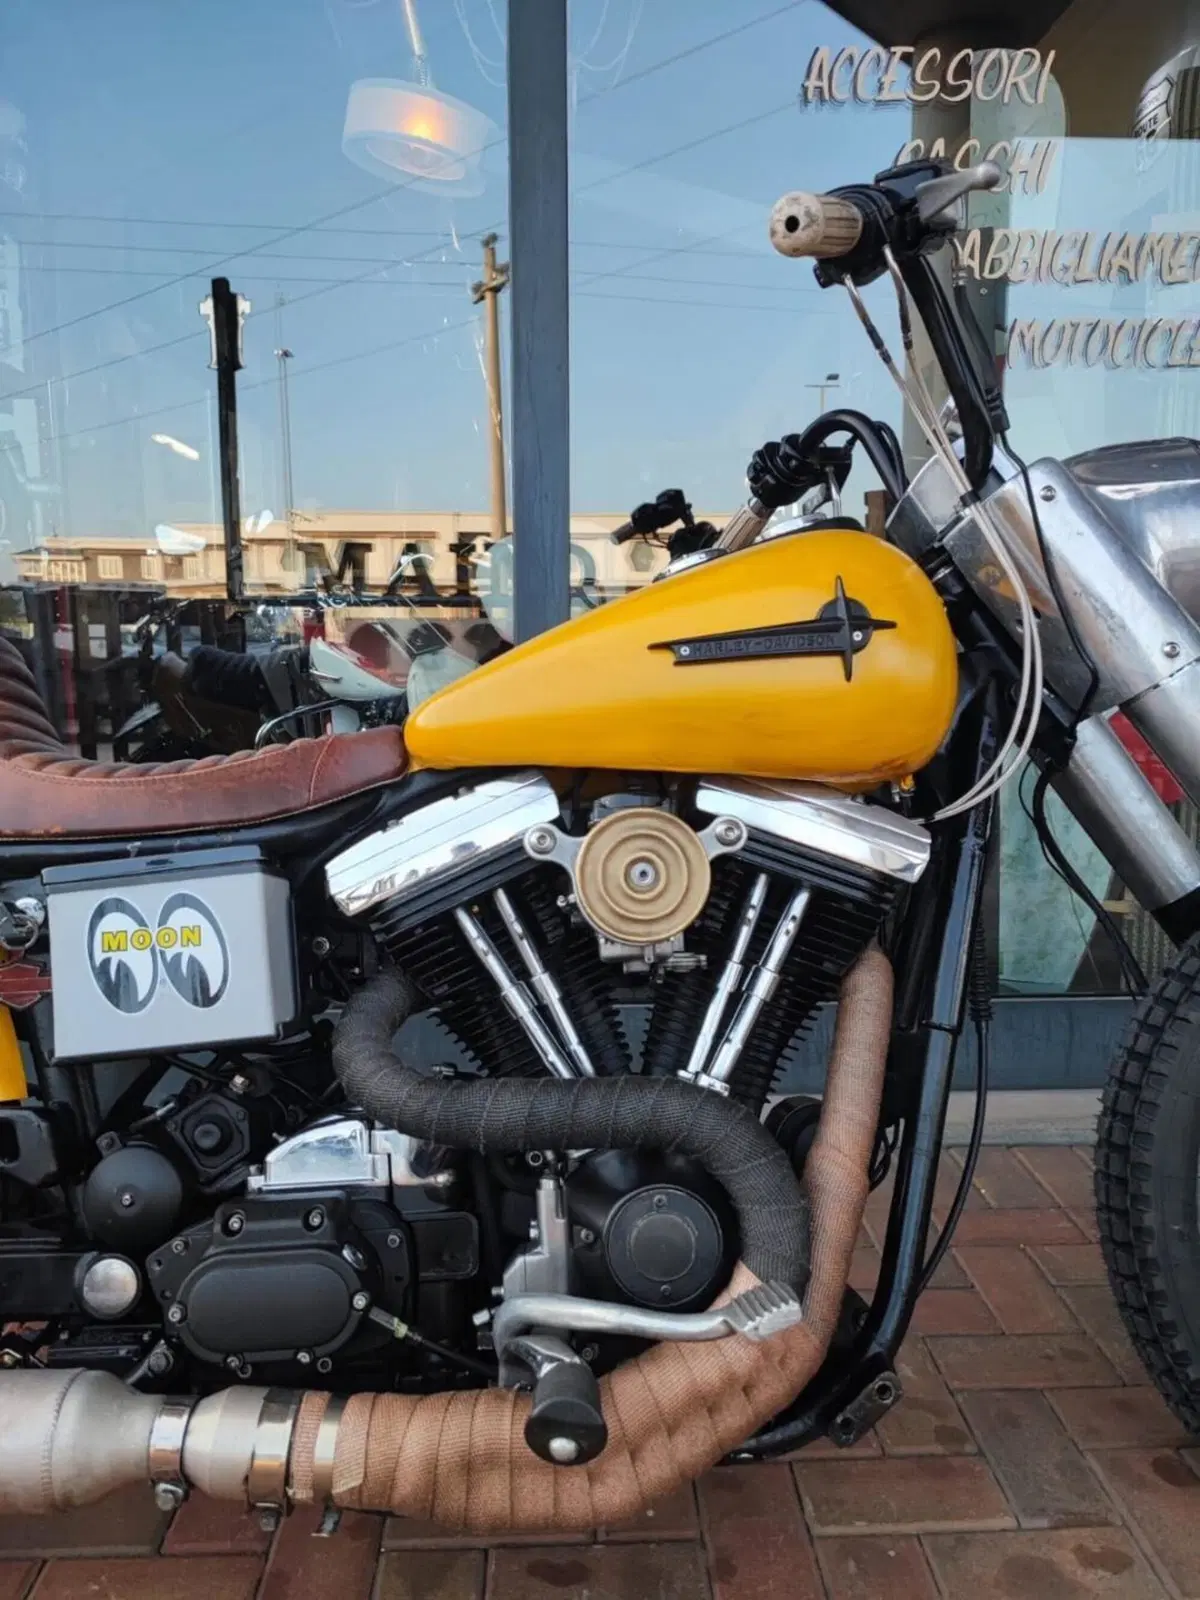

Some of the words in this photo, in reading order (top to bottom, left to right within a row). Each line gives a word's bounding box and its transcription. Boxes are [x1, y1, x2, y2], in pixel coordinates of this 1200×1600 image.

[801, 45, 1056, 106] ACCESSORI
[961, 227, 1200, 287] ABBIGLIAME
[691, 634, 836, 658] HARLEY-DAVIDSON
[101, 925, 202, 953] MOON
